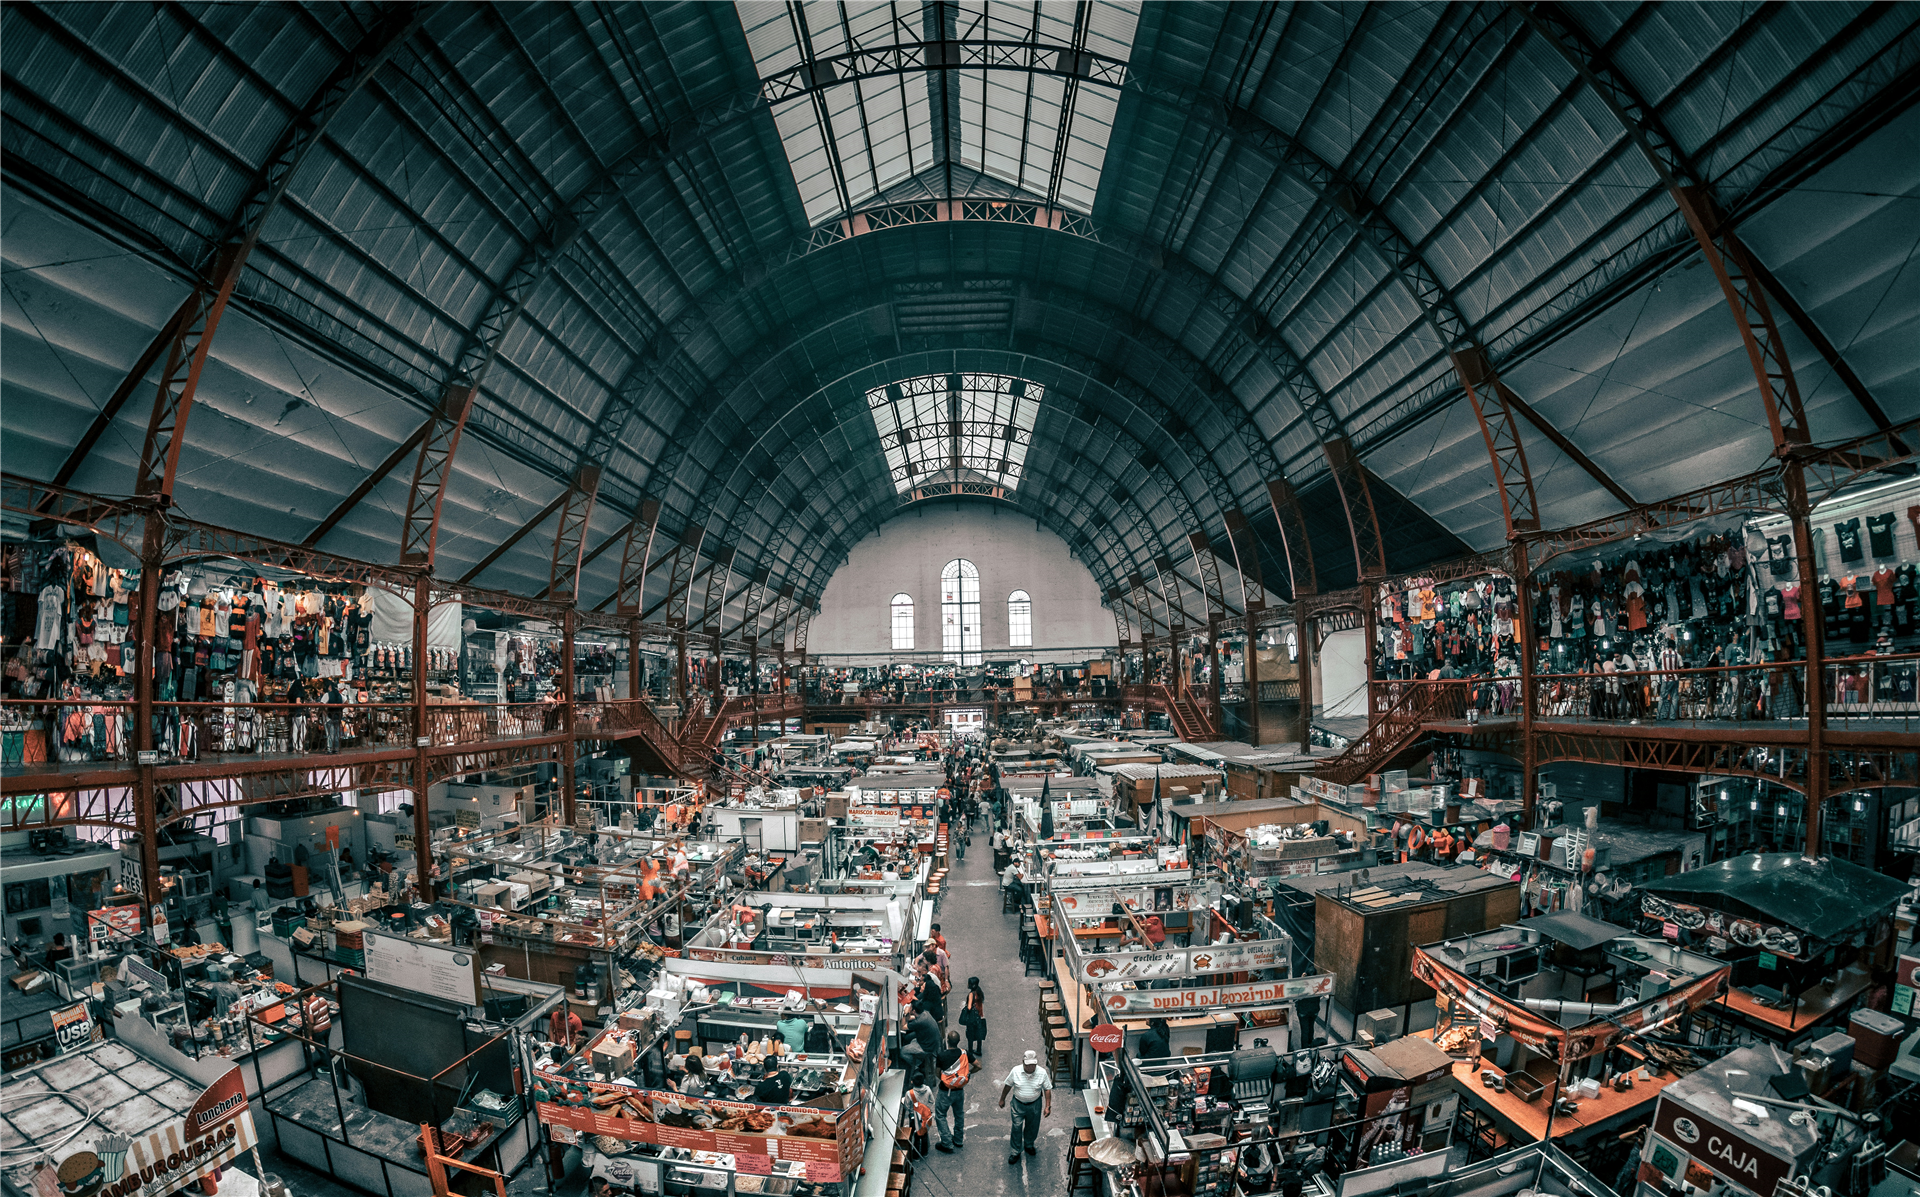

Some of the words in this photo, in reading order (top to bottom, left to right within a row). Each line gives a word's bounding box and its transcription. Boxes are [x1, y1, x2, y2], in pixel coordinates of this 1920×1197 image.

[824, 958, 876, 970] Antojitos
[588, 1081, 628, 1092] BAGUETTE
[652, 1090, 686, 1100] FILETES
[712, 1100, 755, 1110] PECHUGAS
[779, 1106, 819, 1115] COMIDAS
[93, 1123, 236, 1197] AMBURGUESAS
[1708, 1136, 1758, 1179] CAJA
